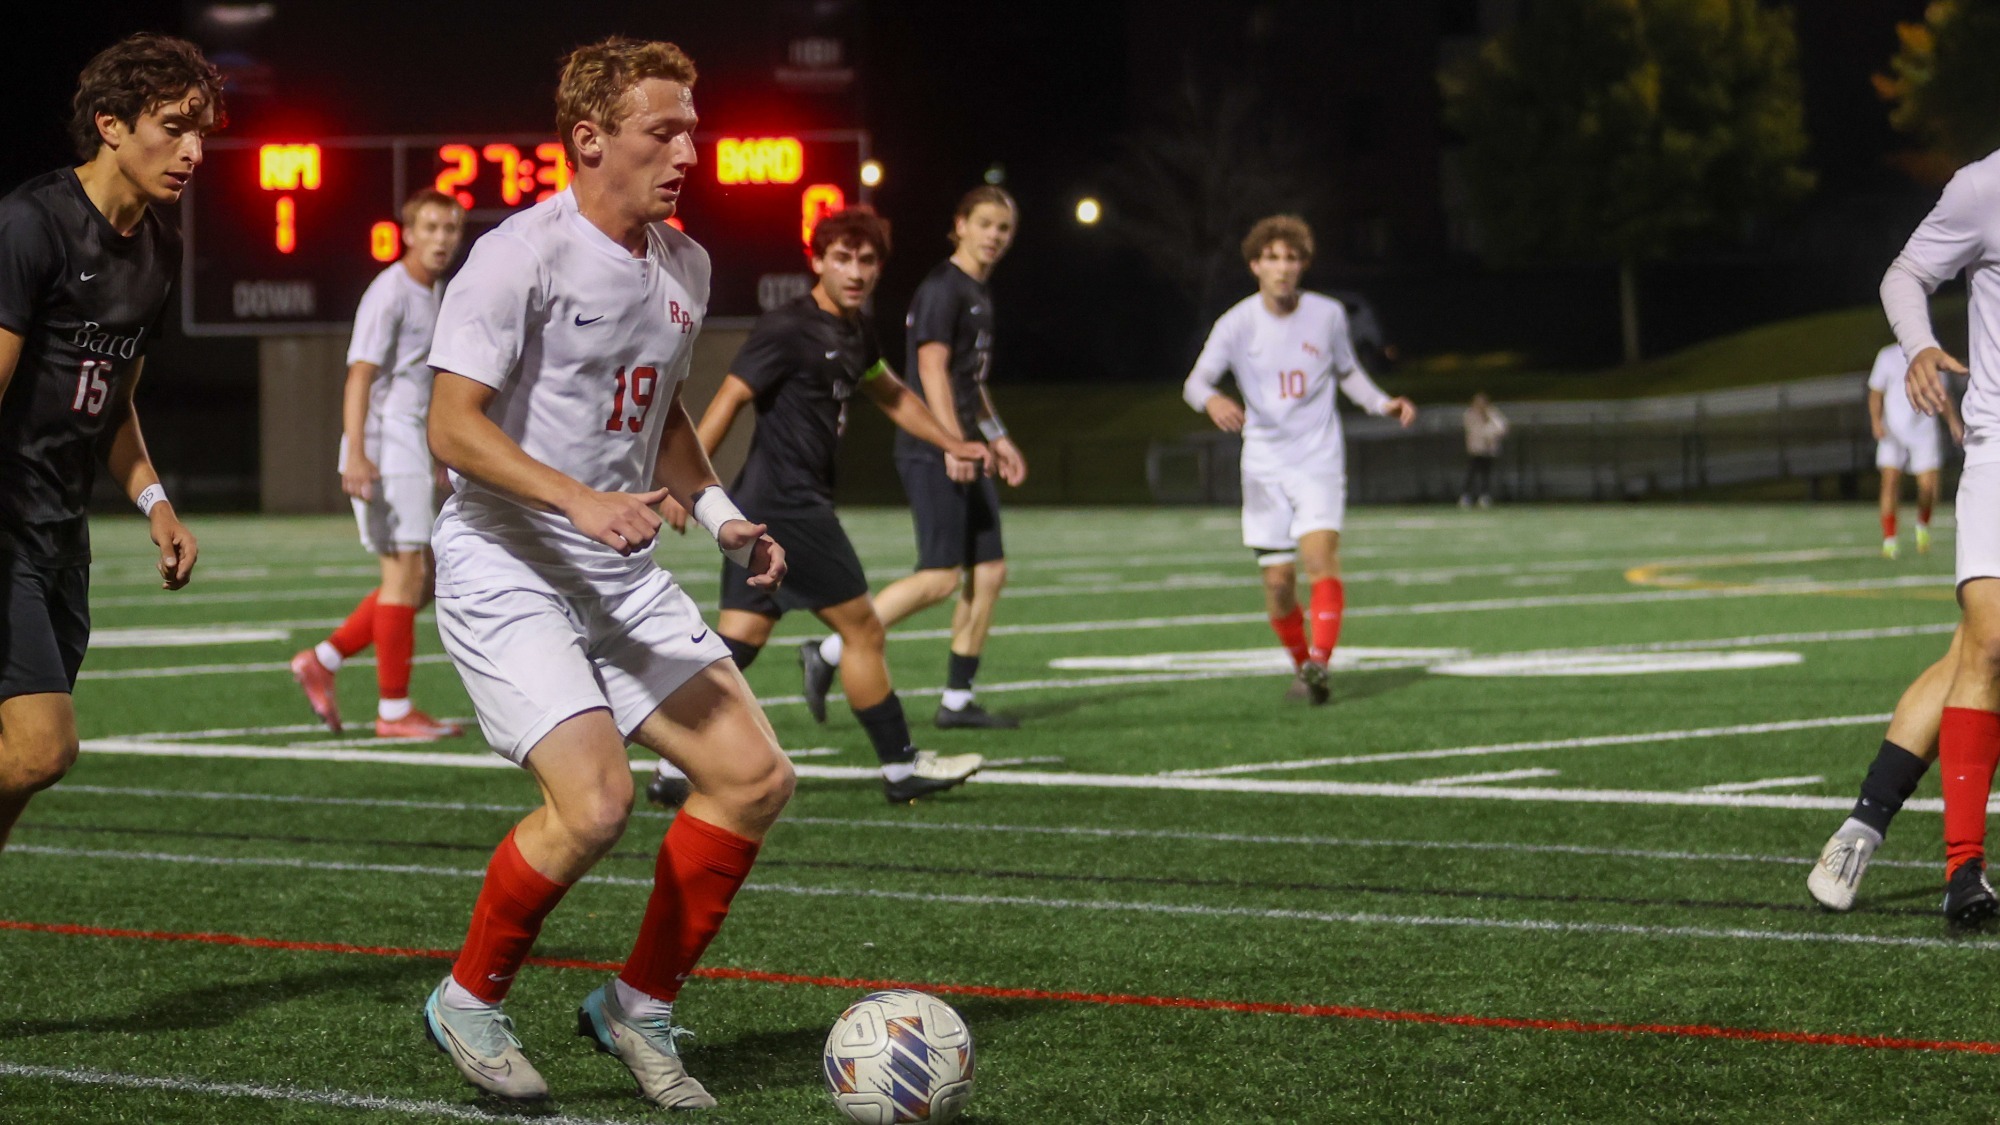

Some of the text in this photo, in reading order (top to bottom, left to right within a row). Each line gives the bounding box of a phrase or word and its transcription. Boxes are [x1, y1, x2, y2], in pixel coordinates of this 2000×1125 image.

[717, 137, 803, 184] BARD
[276, 196, 295, 254] 1
[73, 320, 144, 359] Bard
[71, 358, 112, 416] 15
[605, 366, 658, 433] 19
[1279, 370, 1306, 398] 10
